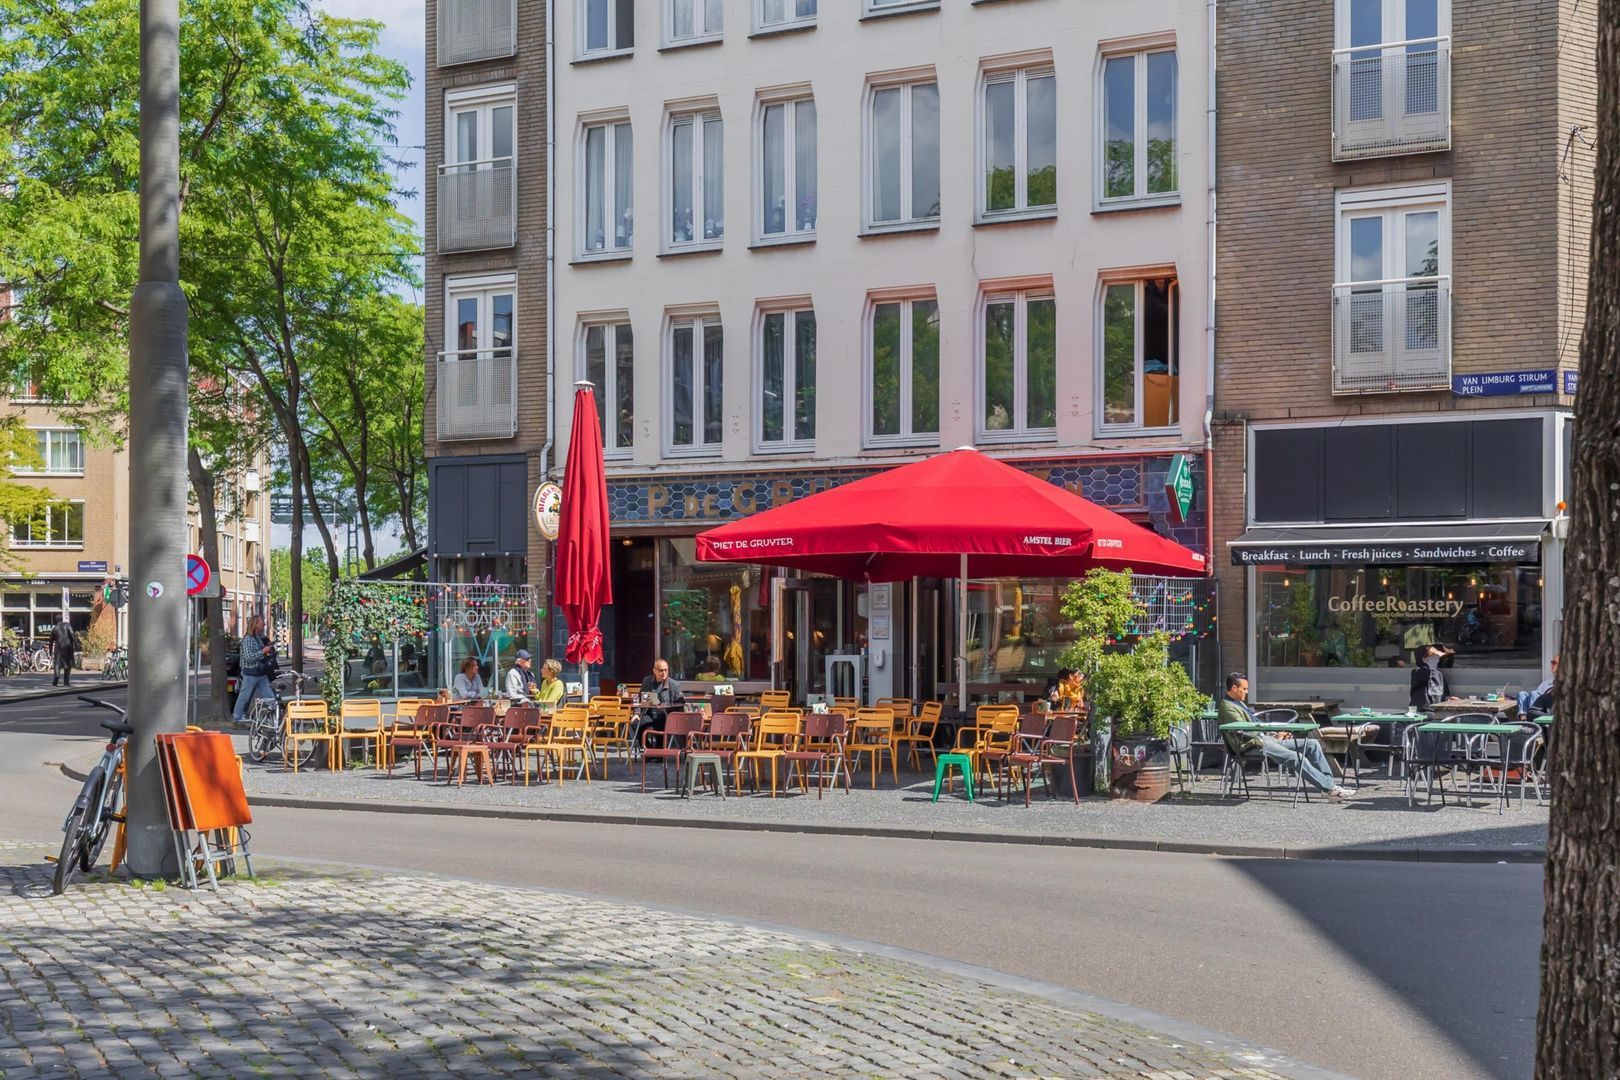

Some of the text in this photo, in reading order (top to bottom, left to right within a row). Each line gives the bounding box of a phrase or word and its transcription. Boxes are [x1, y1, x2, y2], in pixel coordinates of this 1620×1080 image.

[1462, 373, 1547, 385] VAN LIMBURG STIRUM
[1462, 386, 1483, 395] PLEIN
[1567, 382, 1577, 390] STR
[685, 495, 720, 516] DE
[713, 537, 794, 550] PIET DE GRUYTER
[1023, 536, 1072, 546] AMSTEL BIER
[1242, 546, 1525, 561] Breakfast Lunch Fresh juices Sandwiches Coffee
